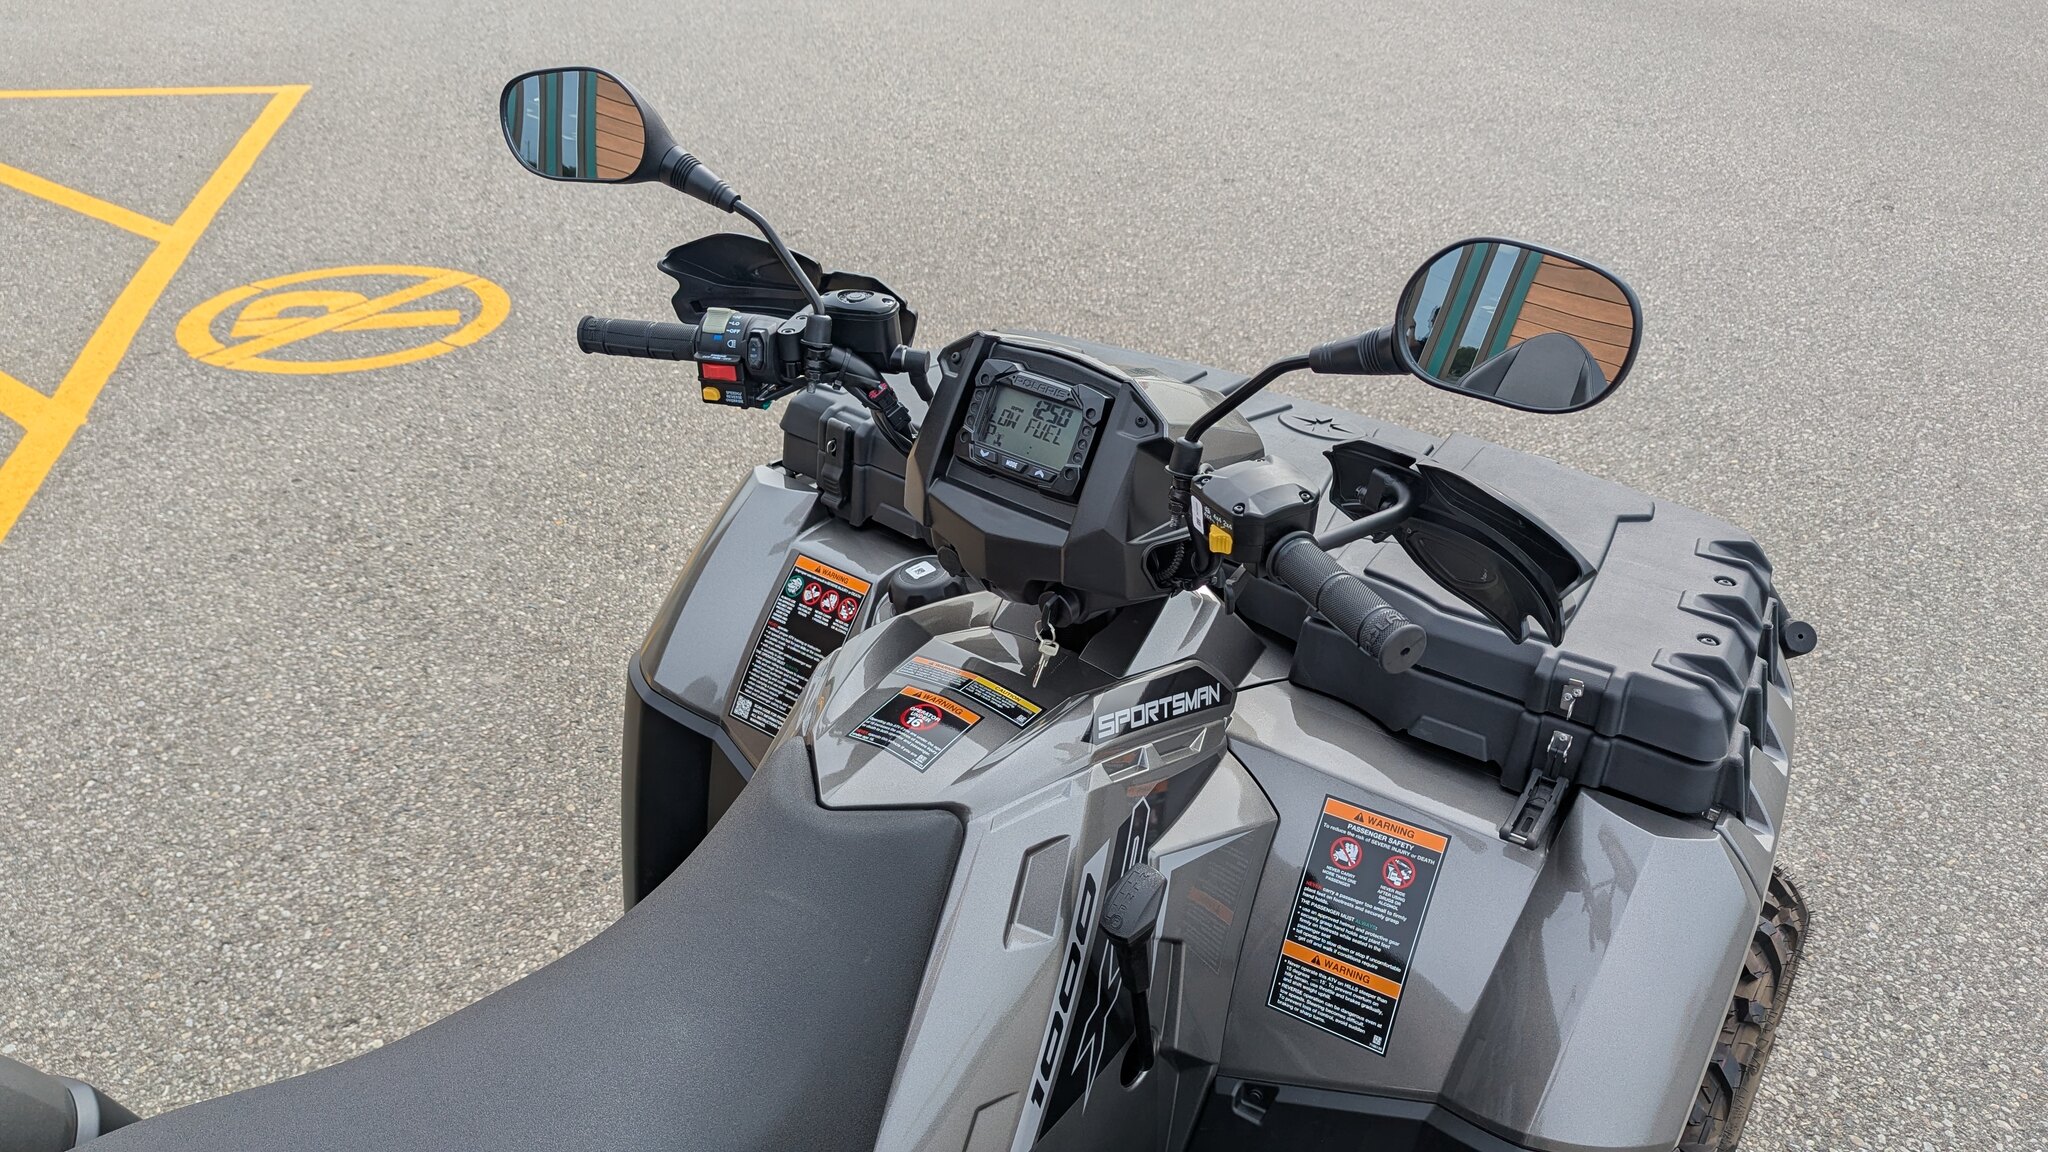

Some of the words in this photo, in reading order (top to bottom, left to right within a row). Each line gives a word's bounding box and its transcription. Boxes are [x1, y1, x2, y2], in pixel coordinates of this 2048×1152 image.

[1014, 376, 1068, 398] POLARIS
[1032, 400, 1073, 428] 1250
[990, 406, 1022, 429] LOW
[1024, 420, 1061, 446] FUEL
[822, 568, 849, 584] WARNING
[922, 694, 963, 715] WARNING
[995, 686, 1022, 702] CAUTION
[910, 706, 941, 721] OPERATOR
[910, 712, 932, 723] UNDER
[1098, 683, 1220, 738] SPORTSMAN
[906, 717, 923, 727] 16
[1347, 823, 1387, 842] PASSENGER
[1387, 837, 1414, 851] SAFETY
[1367, 816, 1415, 839] WARNING
[1329, 824, 1346, 834] reduce
[1370, 838, 1390, 849] SEVERE
[1390, 845, 1410, 856] INJURY
[1417, 854, 1435, 865] DEATH
[1325, 875, 1350, 887] PASSENGER
[1326, 865, 1340, 873] NEVER
[1340, 870, 1355, 879] CARRY
[1310, 901, 1340, 916] PASSENGER
[1340, 912, 1354, 922] MUST
[1323, 958, 1370, 984] WARNING
[1030, 873, 1096, 1109] 1000
